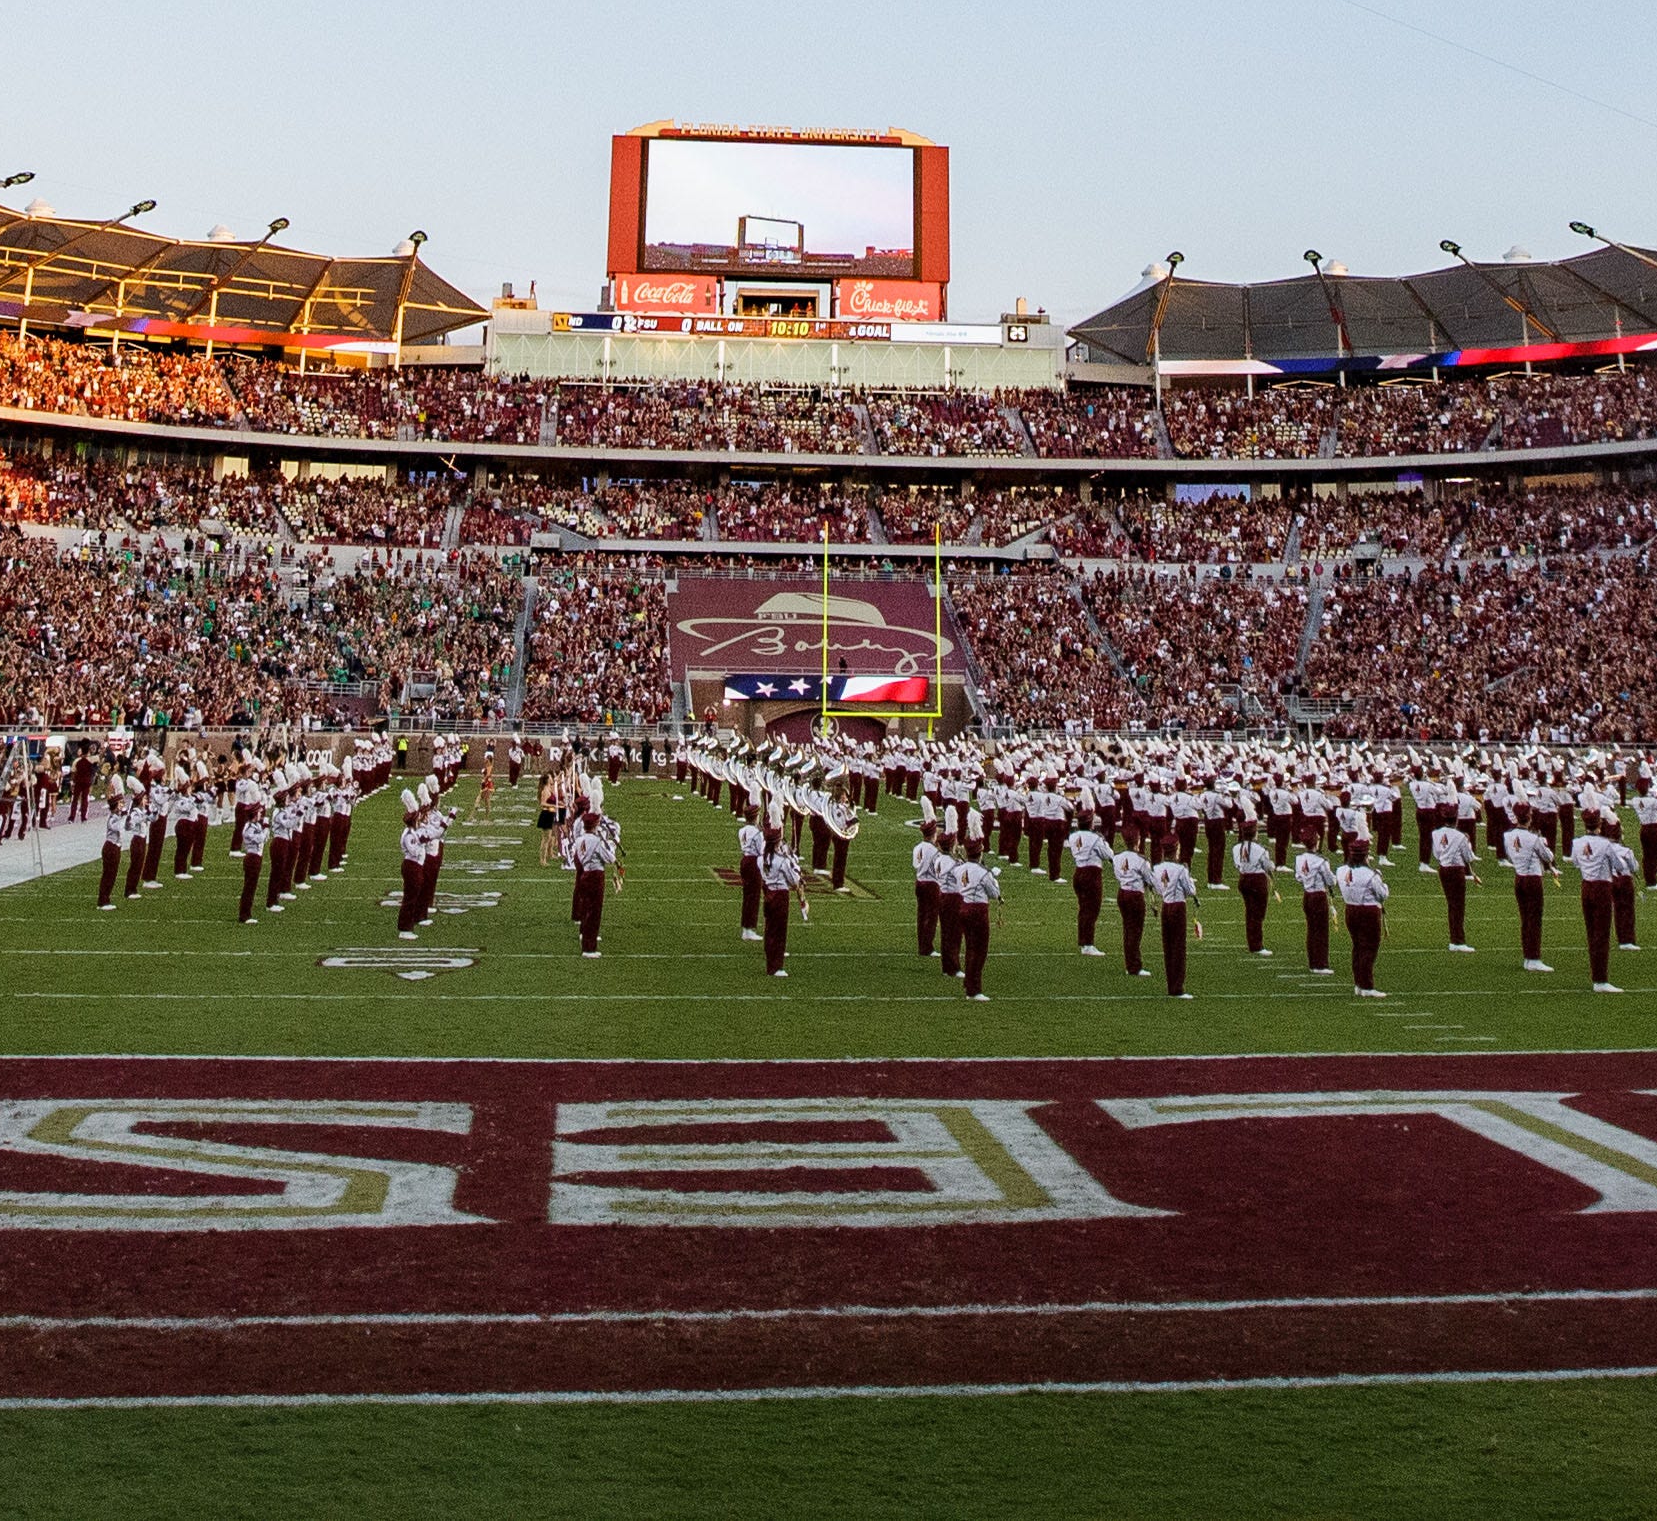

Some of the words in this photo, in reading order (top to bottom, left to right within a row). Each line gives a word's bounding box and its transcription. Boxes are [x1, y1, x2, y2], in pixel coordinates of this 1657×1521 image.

[680, 122, 741, 137] FLORIDA
[747, 124, 793, 139] STATE
[799, 126, 881, 142] UNIVERSITY
[634, 282, 697, 304] Coca-Cola
[612, 315, 622, 330] 0
[637, 318, 658, 329] FSU
[681, 318, 692, 332] 0
[696, 320, 723, 333] BALL
[727, 321, 744, 334] ON
[771, 321, 809, 336] 10:10
